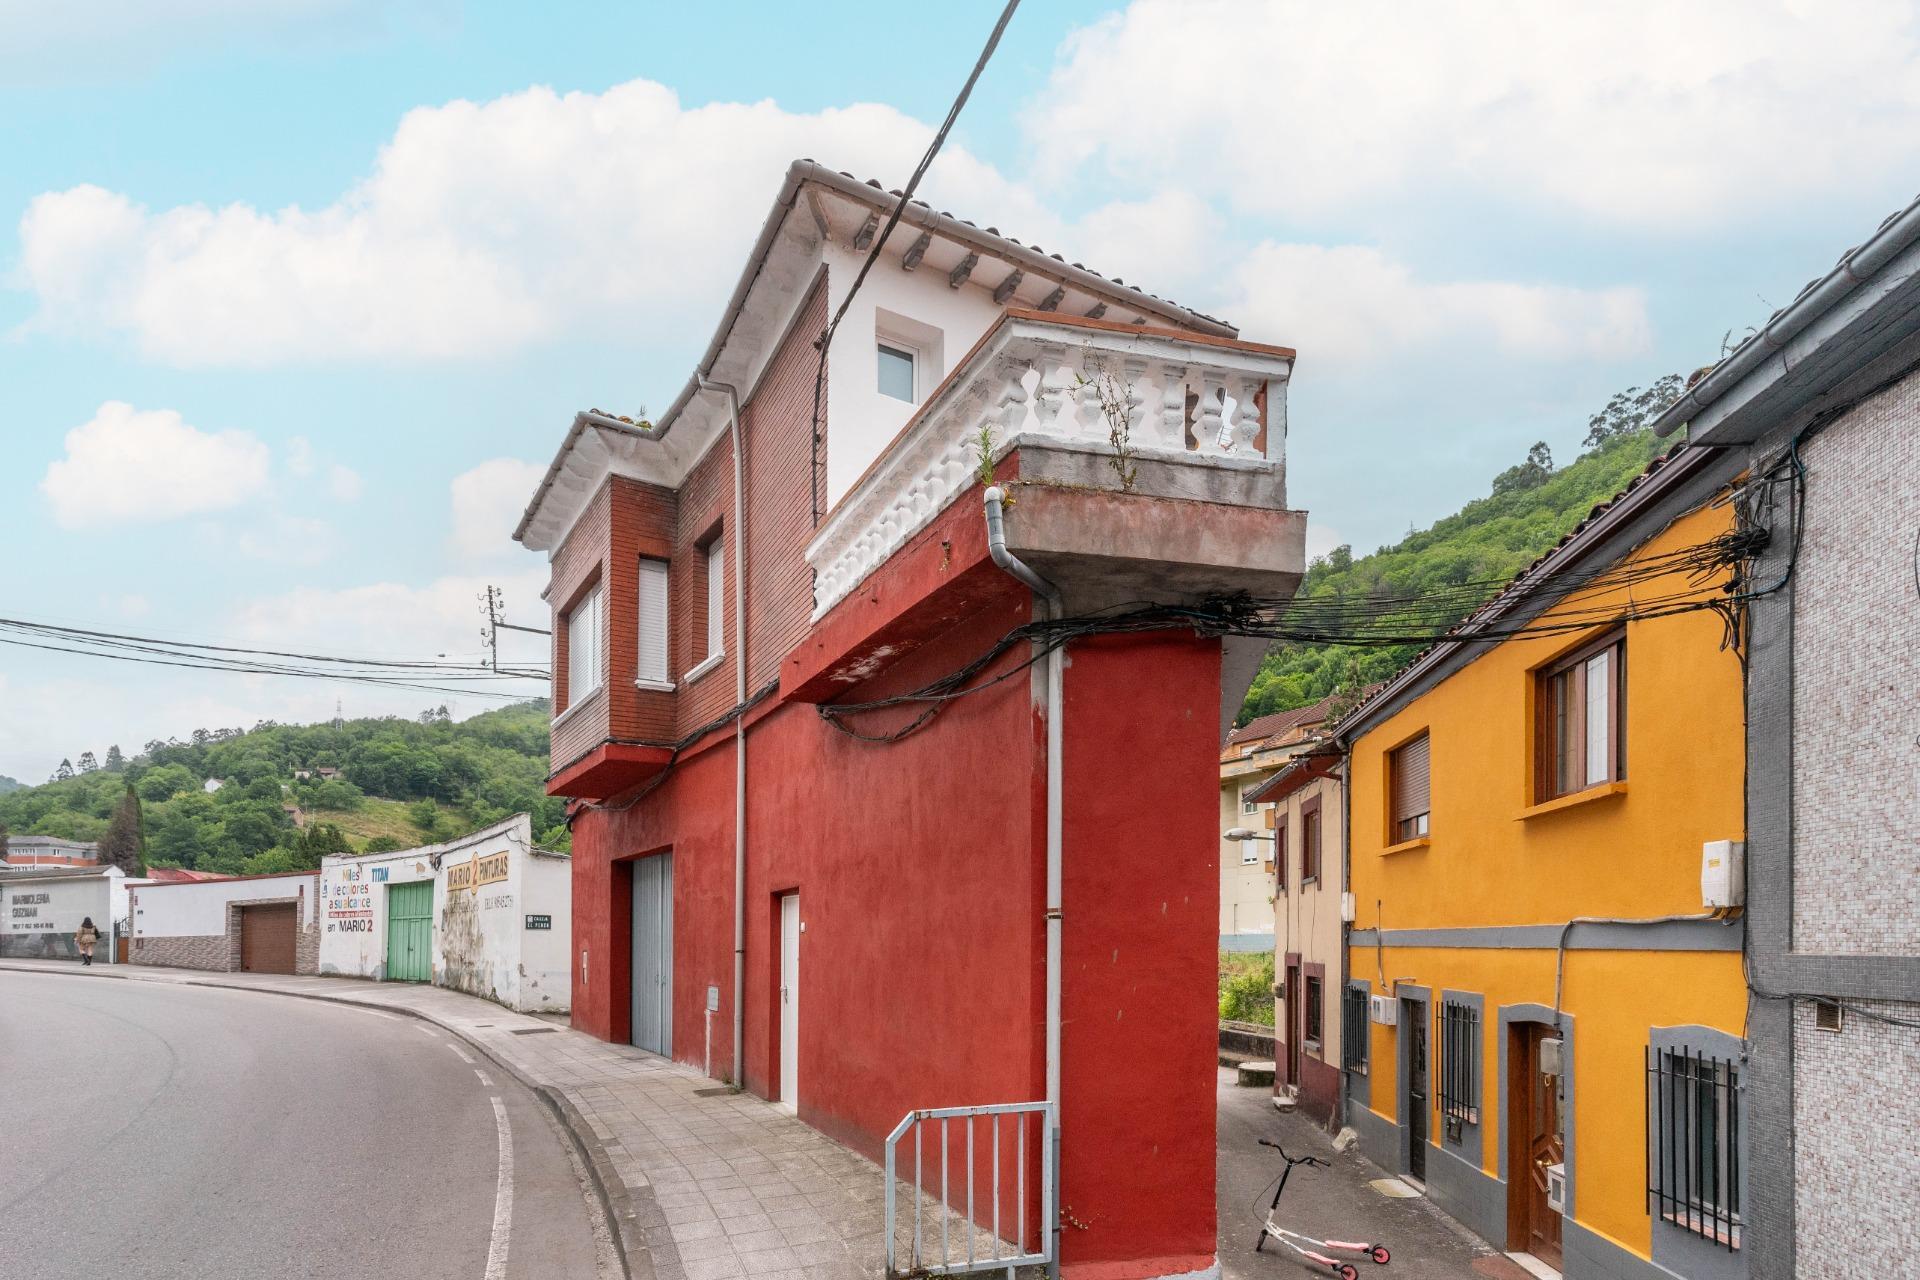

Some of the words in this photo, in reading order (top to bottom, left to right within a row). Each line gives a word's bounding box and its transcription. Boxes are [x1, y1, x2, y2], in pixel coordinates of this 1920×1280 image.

[343, 867, 360, 881] Miles
[371, 866, 389, 882] TITAN
[448, 866, 471, 887] MARIO
[472, 860, 478, 886] 2
[480, 856, 508, 880] PINTURAS
[342, 883, 369, 896] colores
[329, 899, 334, 909] a
[343, 896, 371, 909] alcance
[328, 923, 336, 933] en
[340, 919, 366, 932] MARIO
[367, 919, 373, 932] 2
